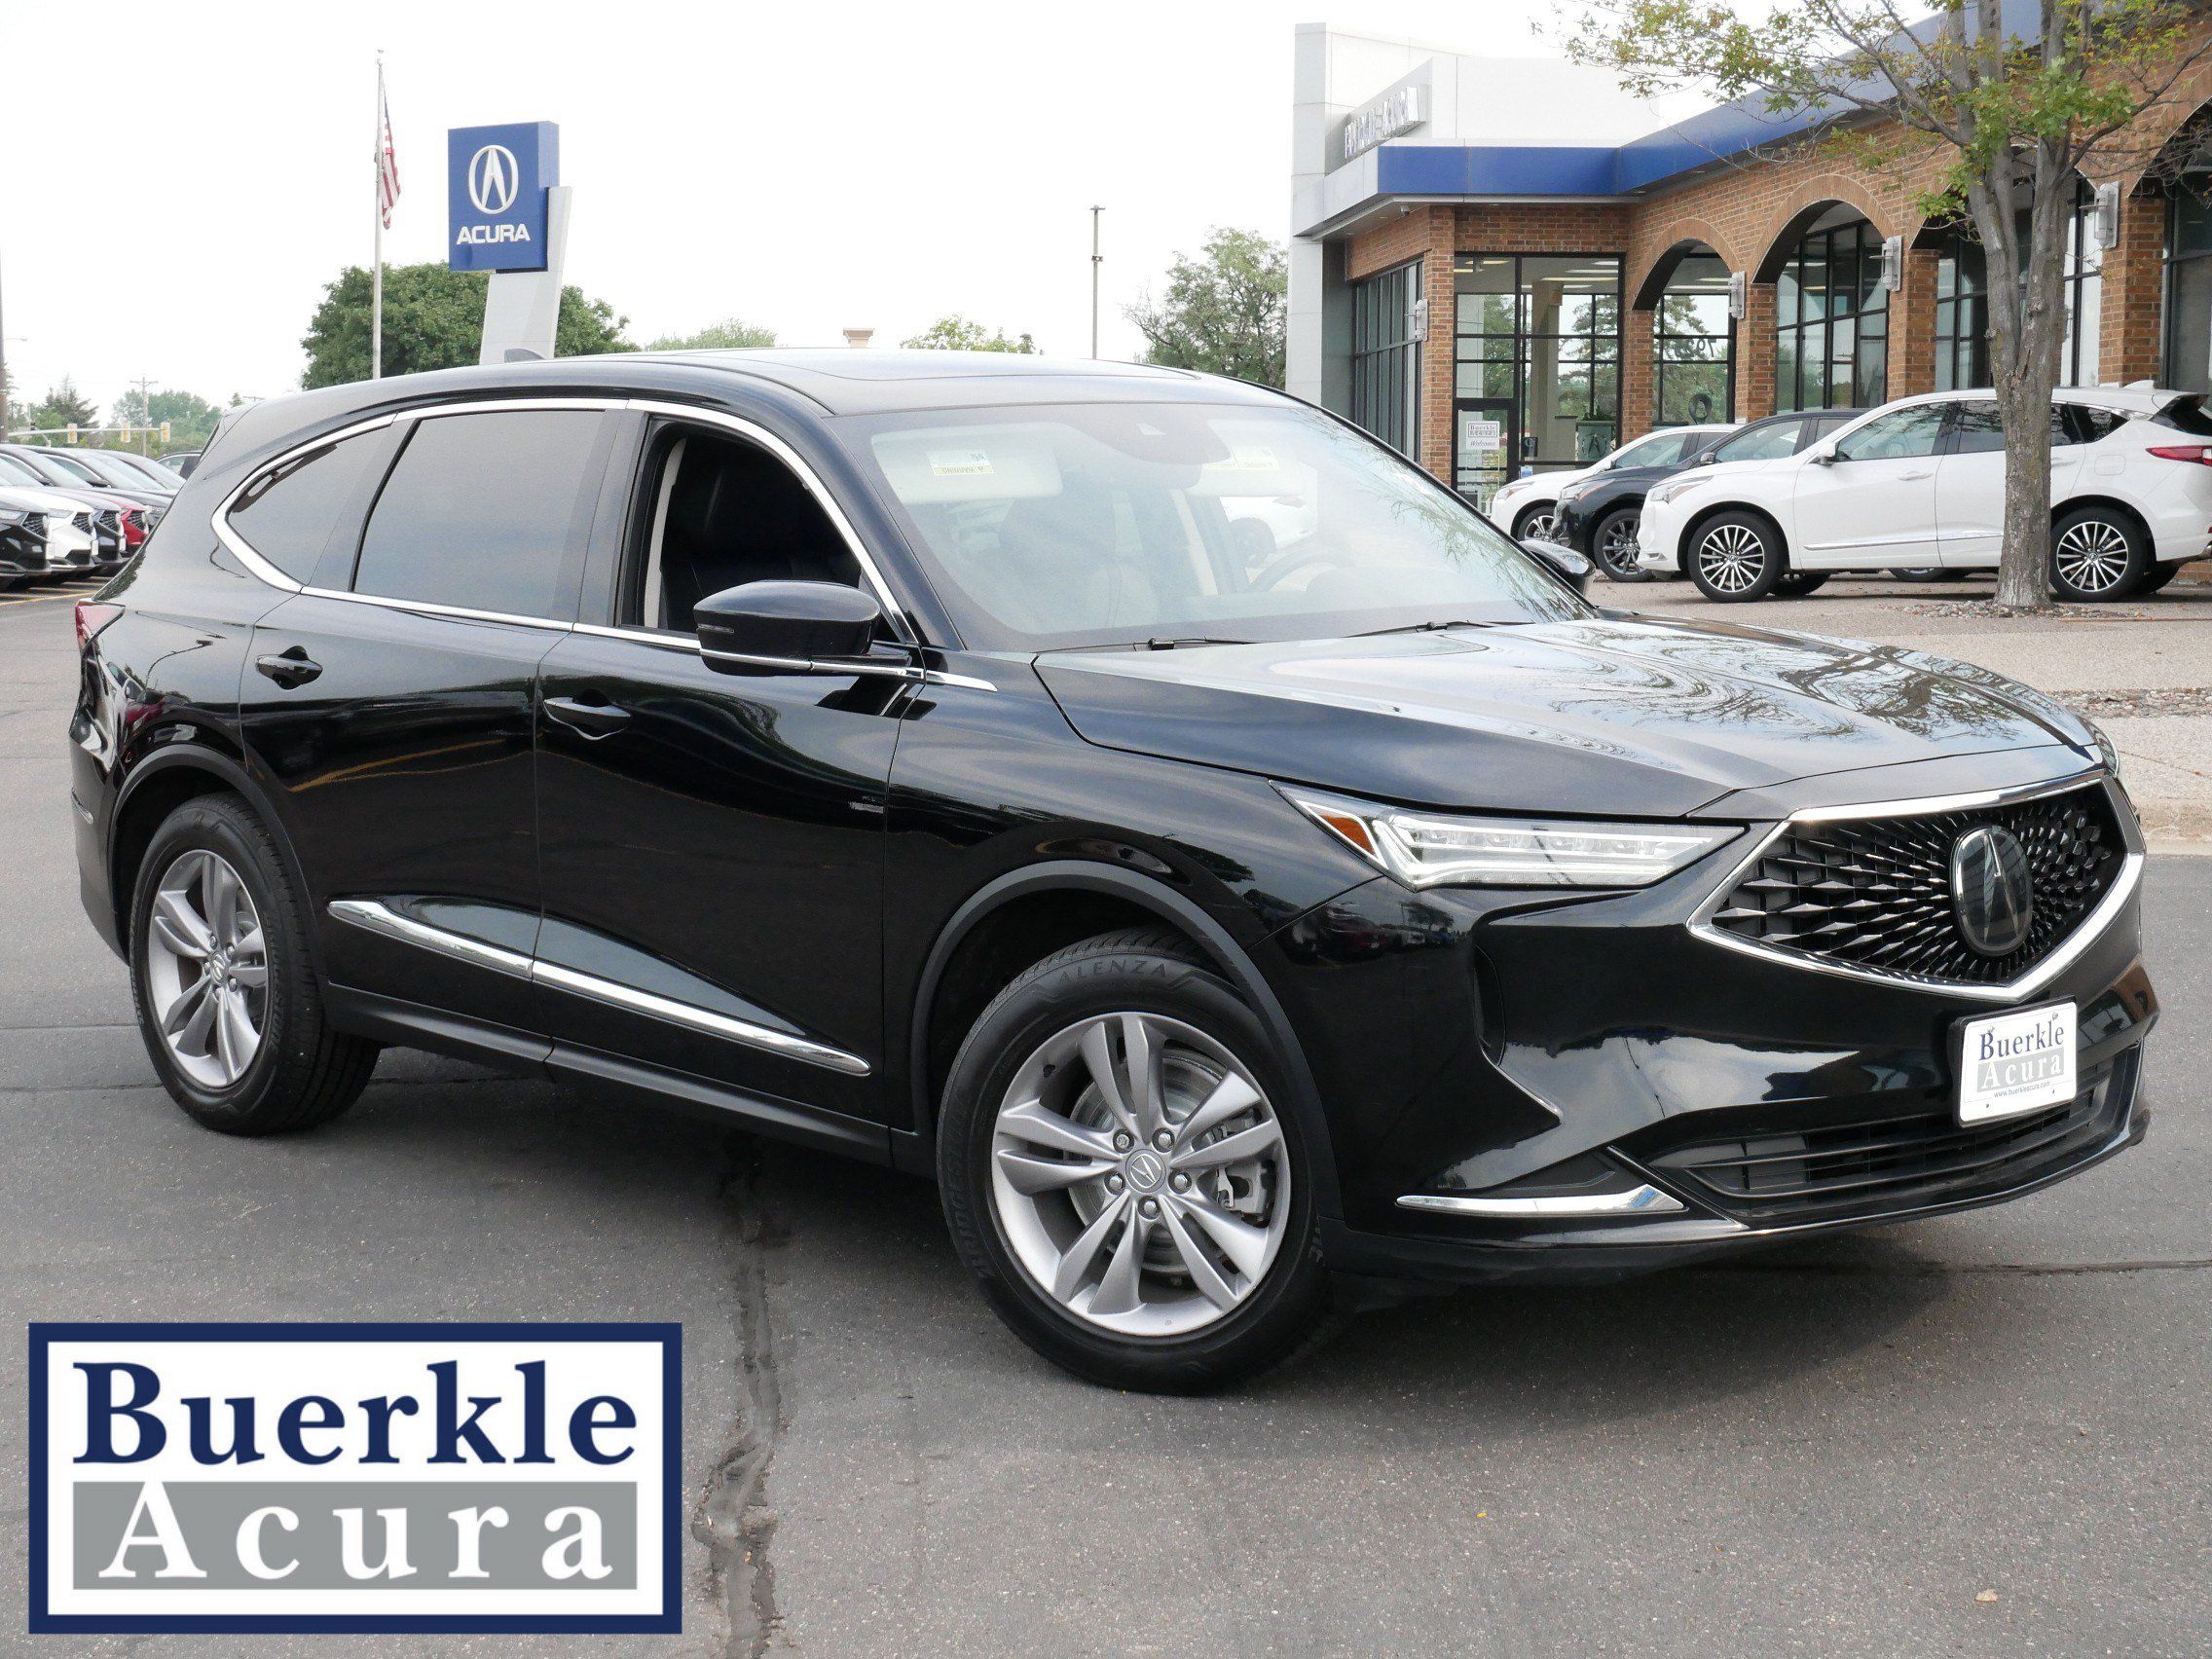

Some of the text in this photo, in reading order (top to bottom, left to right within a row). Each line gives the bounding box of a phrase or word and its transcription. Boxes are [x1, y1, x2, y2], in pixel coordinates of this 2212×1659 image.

[456, 223, 531, 244] ACURA
[1059, 959, 1166, 982] ALENZA
[1978, 1019, 2064, 1061] Buerkle
[1981, 1053, 2061, 1089] Acura
